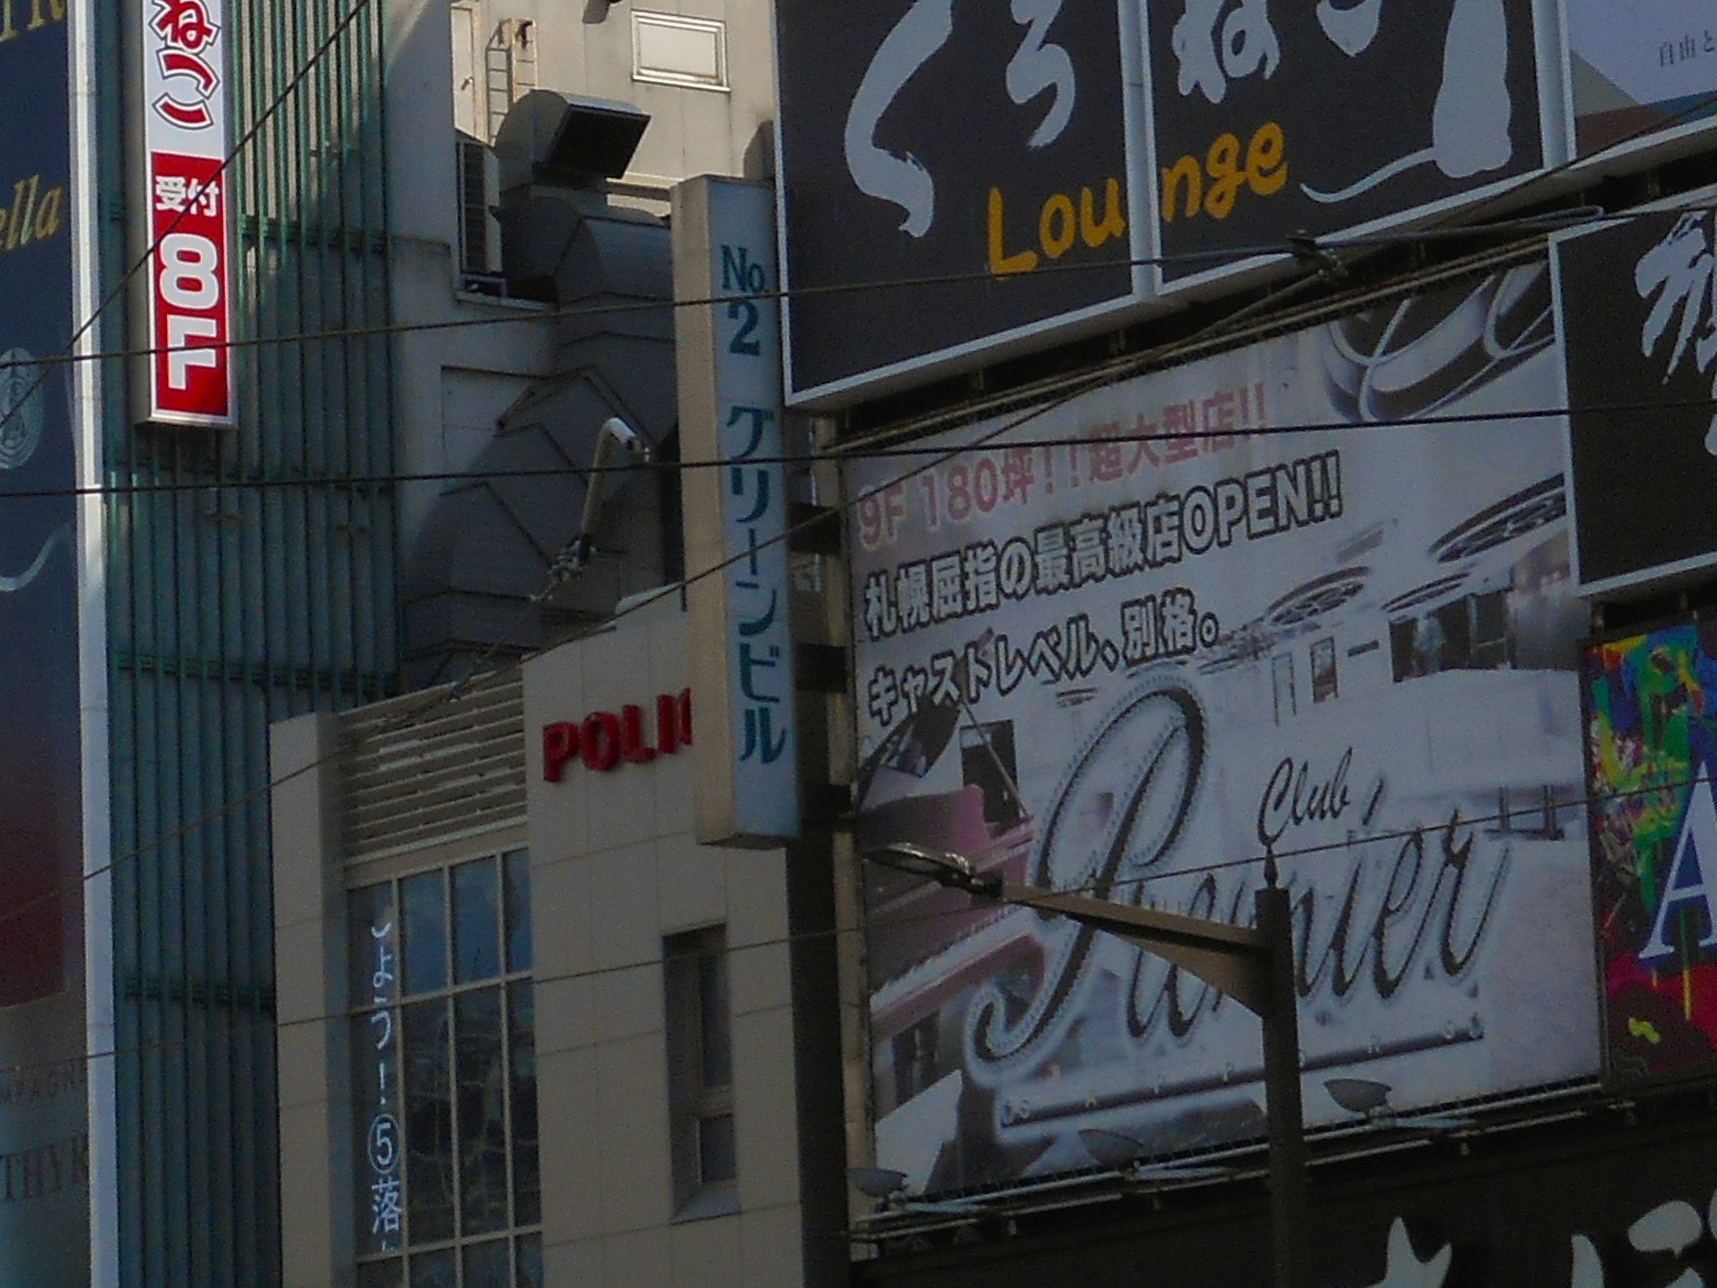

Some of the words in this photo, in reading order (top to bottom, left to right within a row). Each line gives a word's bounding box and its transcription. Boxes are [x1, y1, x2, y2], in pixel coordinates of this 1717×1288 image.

[155, 175, 219, 218] 受付
[987, 119, 1288, 278] Lounge
[159, 232, 219, 390] 8F
[727, 406, 787, 766] グリーンビル
[1257, 748, 1352, 848] Club
